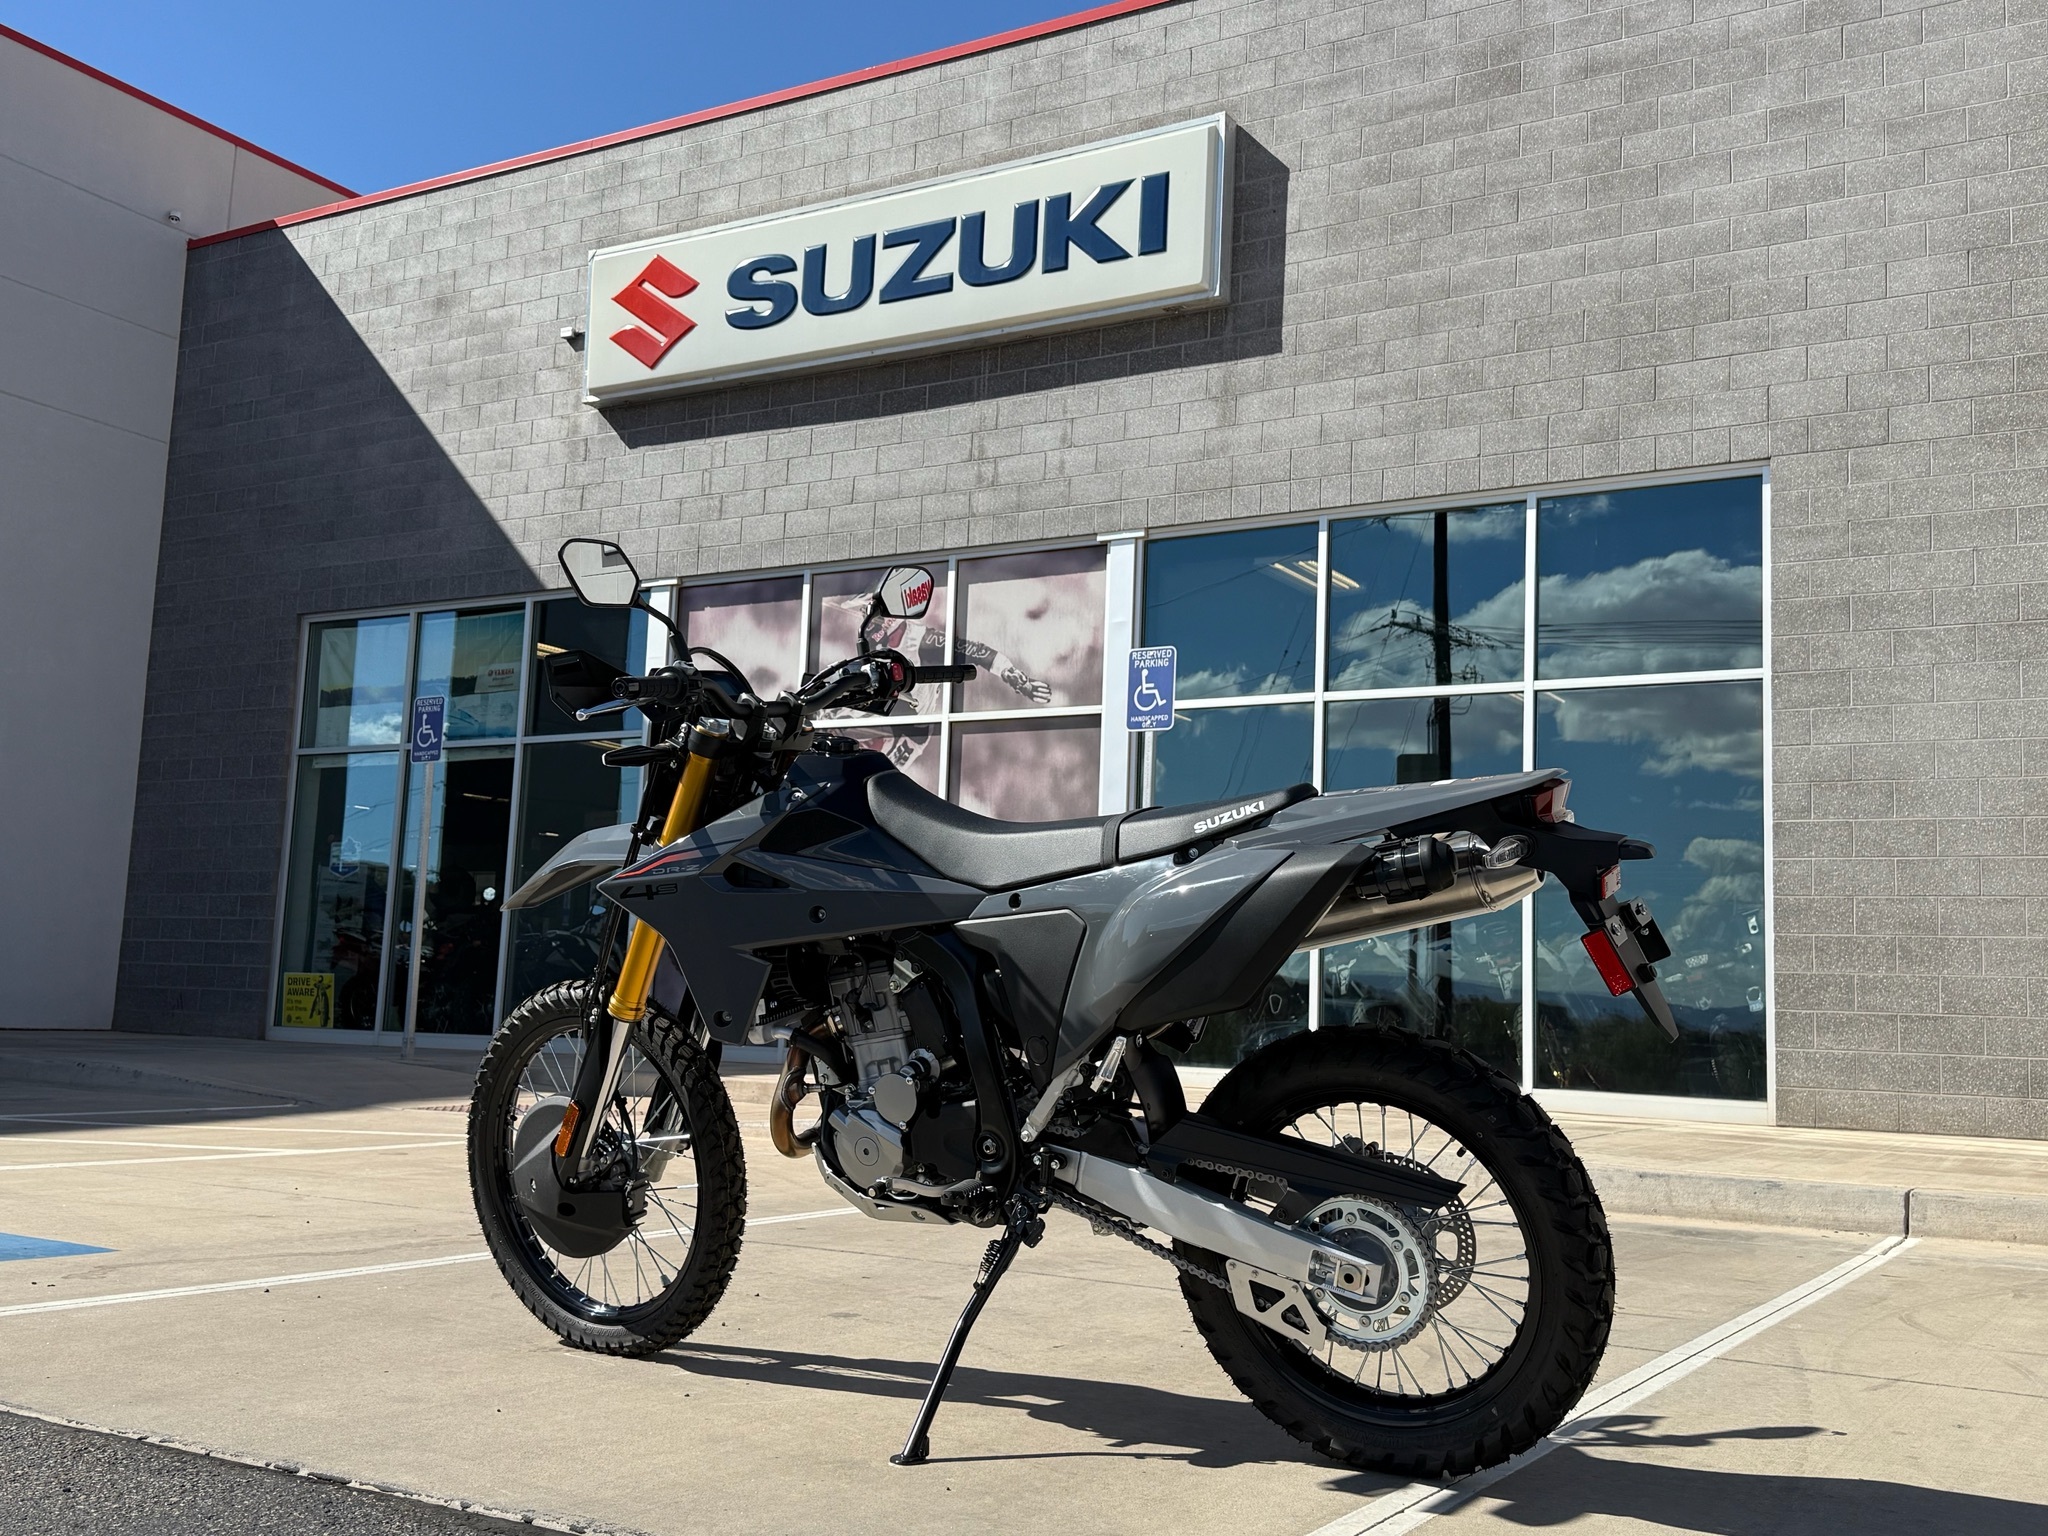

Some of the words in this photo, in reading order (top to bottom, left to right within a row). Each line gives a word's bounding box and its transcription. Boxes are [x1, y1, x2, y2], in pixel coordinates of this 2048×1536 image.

[724, 170, 1170, 331] SUZUKI
[1132, 649, 1172, 661] RESERVED
[1134, 658, 1169, 669] PARKING
[417, 698, 443, 707] RESERVED
[418, 705, 441, 713] PARKING
[1130, 714, 1169, 722] HANDICAPPED
[1193, 800, 1265, 834] SUZUKI
[652, 864, 700, 875] DR-Z
[620, 883, 678, 900] 4S
[287, 977, 311, 986] DRIVE
[287, 987, 315, 997] AWARE
